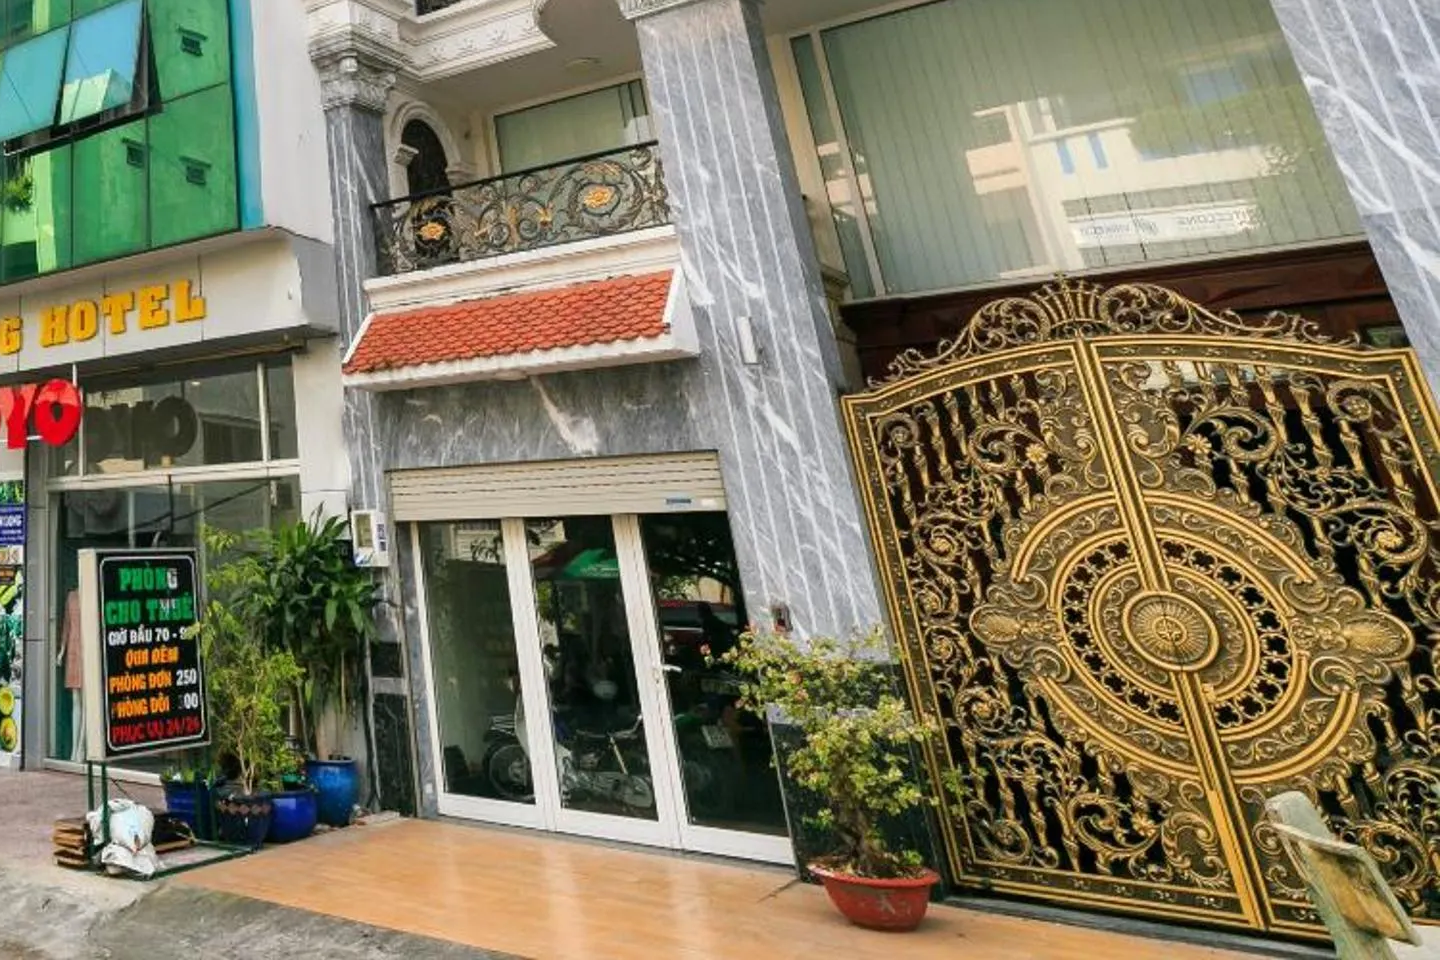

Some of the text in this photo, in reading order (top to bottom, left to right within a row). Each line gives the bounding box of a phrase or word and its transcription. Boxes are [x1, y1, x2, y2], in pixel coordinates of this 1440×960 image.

[40, 278, 207, 349] HOTEL
[118, 560, 178, 592] PHÒNG
[105, 599, 141, 626] CHO
[154, 626, 170, 642] 70
[109, 671, 147, 694] PHÒNG
[176, 668, 198, 686] 250
